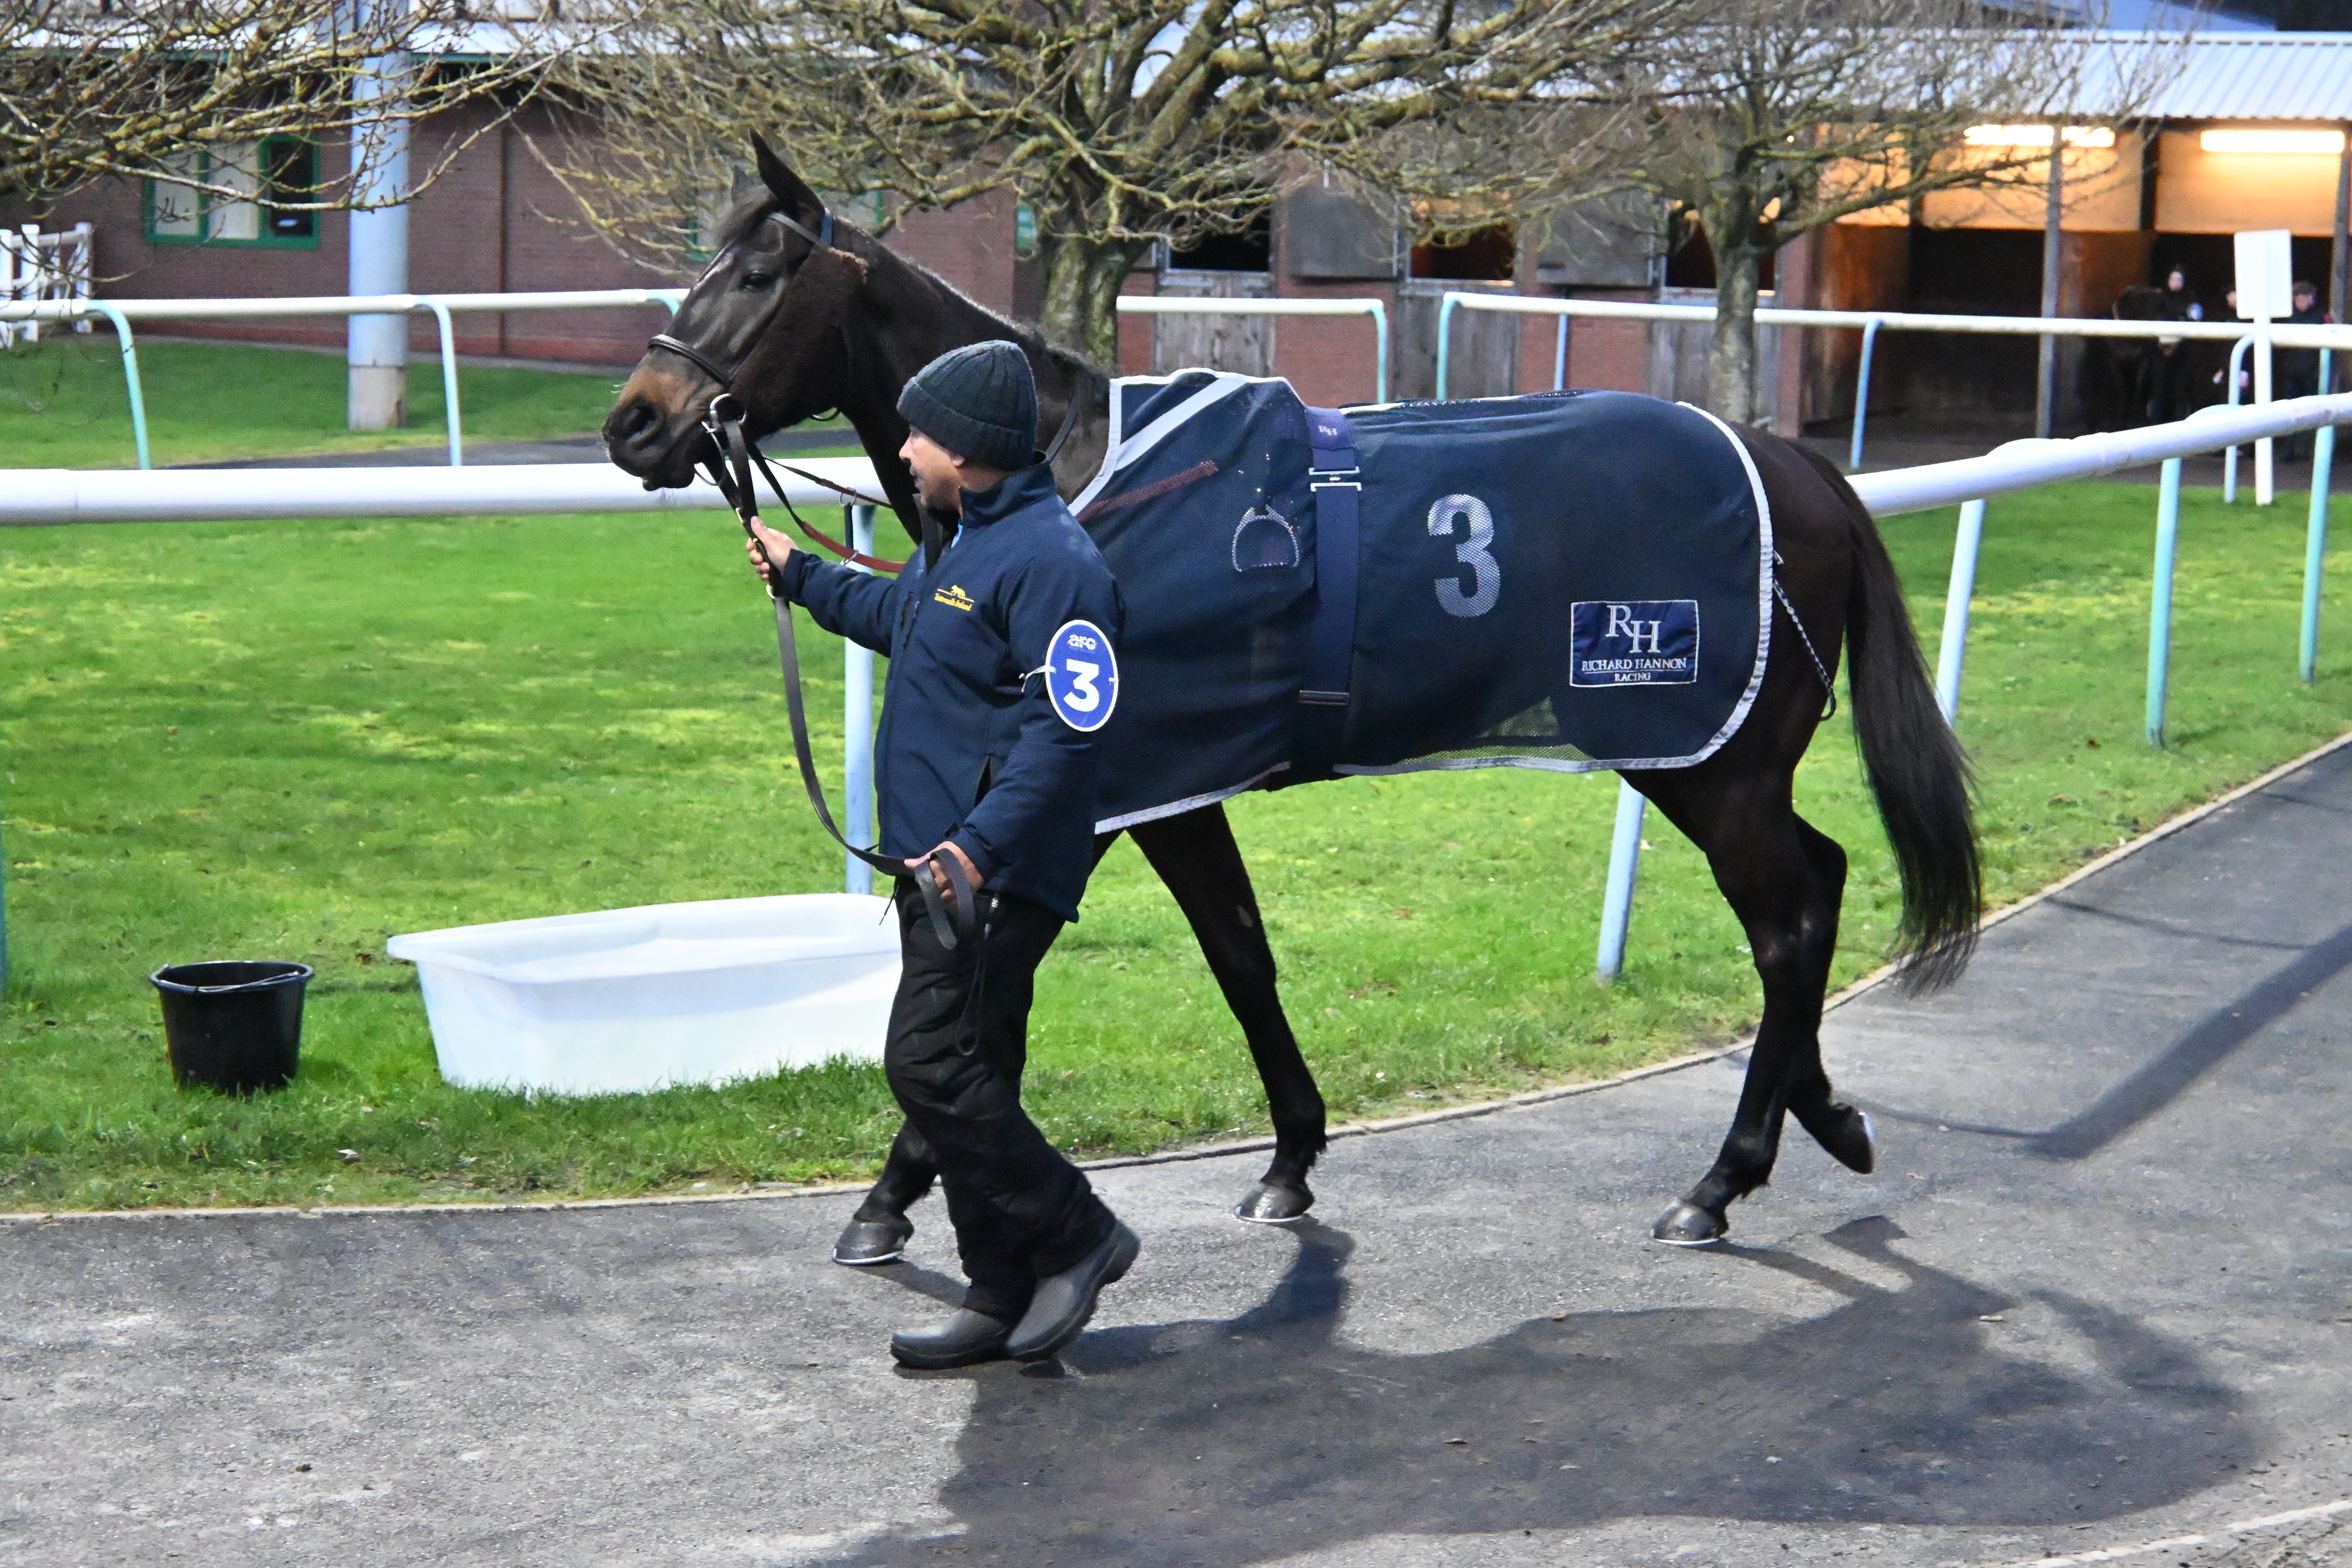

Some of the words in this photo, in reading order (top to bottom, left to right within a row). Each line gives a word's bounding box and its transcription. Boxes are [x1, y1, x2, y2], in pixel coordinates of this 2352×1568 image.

[1427, 493, 1500, 618] 3
[1605, 604, 1662, 653] RH
[1063, 658, 1100, 712] 3
[1582, 659, 1632, 672] RICHARD
[1634, 657, 1687, 670] HANNON
[1614, 672, 1651, 682] RACING
